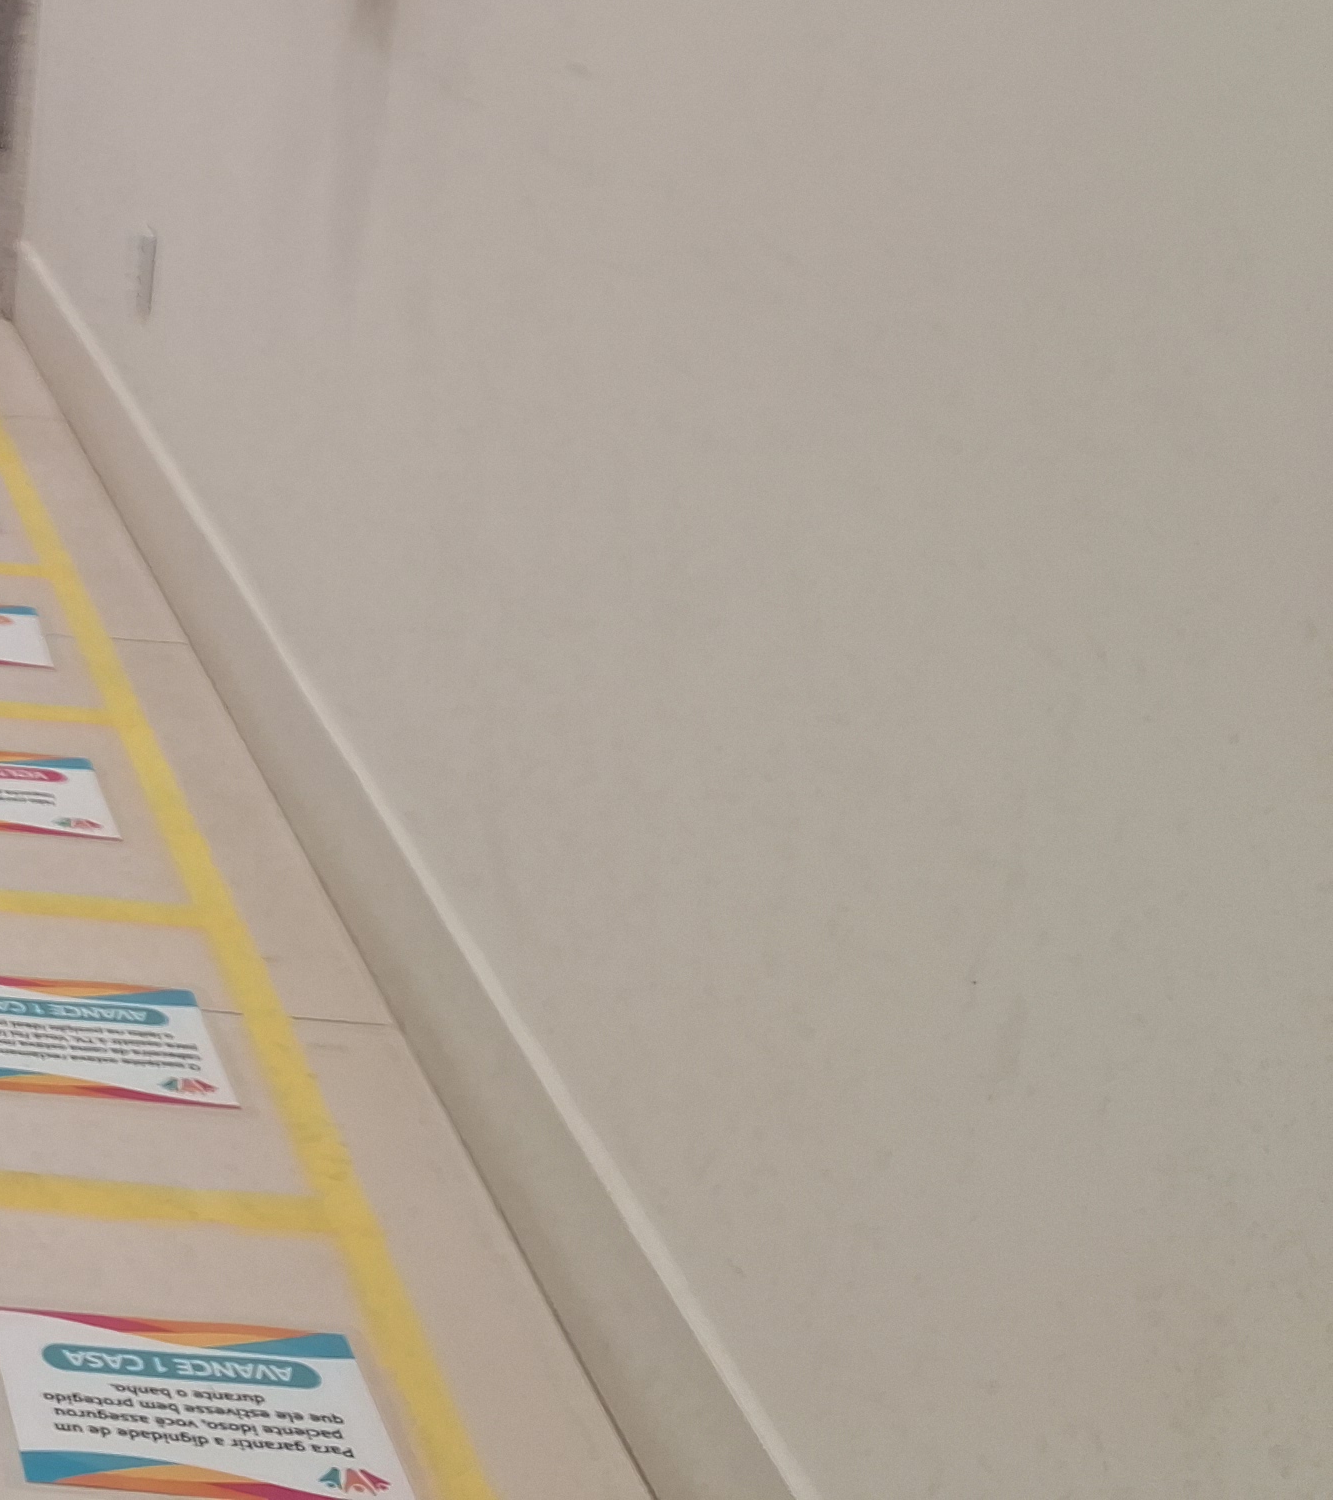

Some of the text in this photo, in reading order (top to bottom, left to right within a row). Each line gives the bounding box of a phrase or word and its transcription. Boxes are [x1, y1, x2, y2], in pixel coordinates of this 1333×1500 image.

[31, 1003, 44, 1013] 1
[48, 1005, 147, 1021] AVANCE
[61, 1349, 293, 1381] AVANCE 1 CASA
[176, 1389, 187, 1397] o
[193, 1391, 265, 1406] durante
[42, 1392, 344, 1425] que ele estivesse bem protegido
[53, 1407, 343, 1440] paciente idoso, você assegurou
[54, 1423, 355, 1459] Para garantir a dignidade de um
